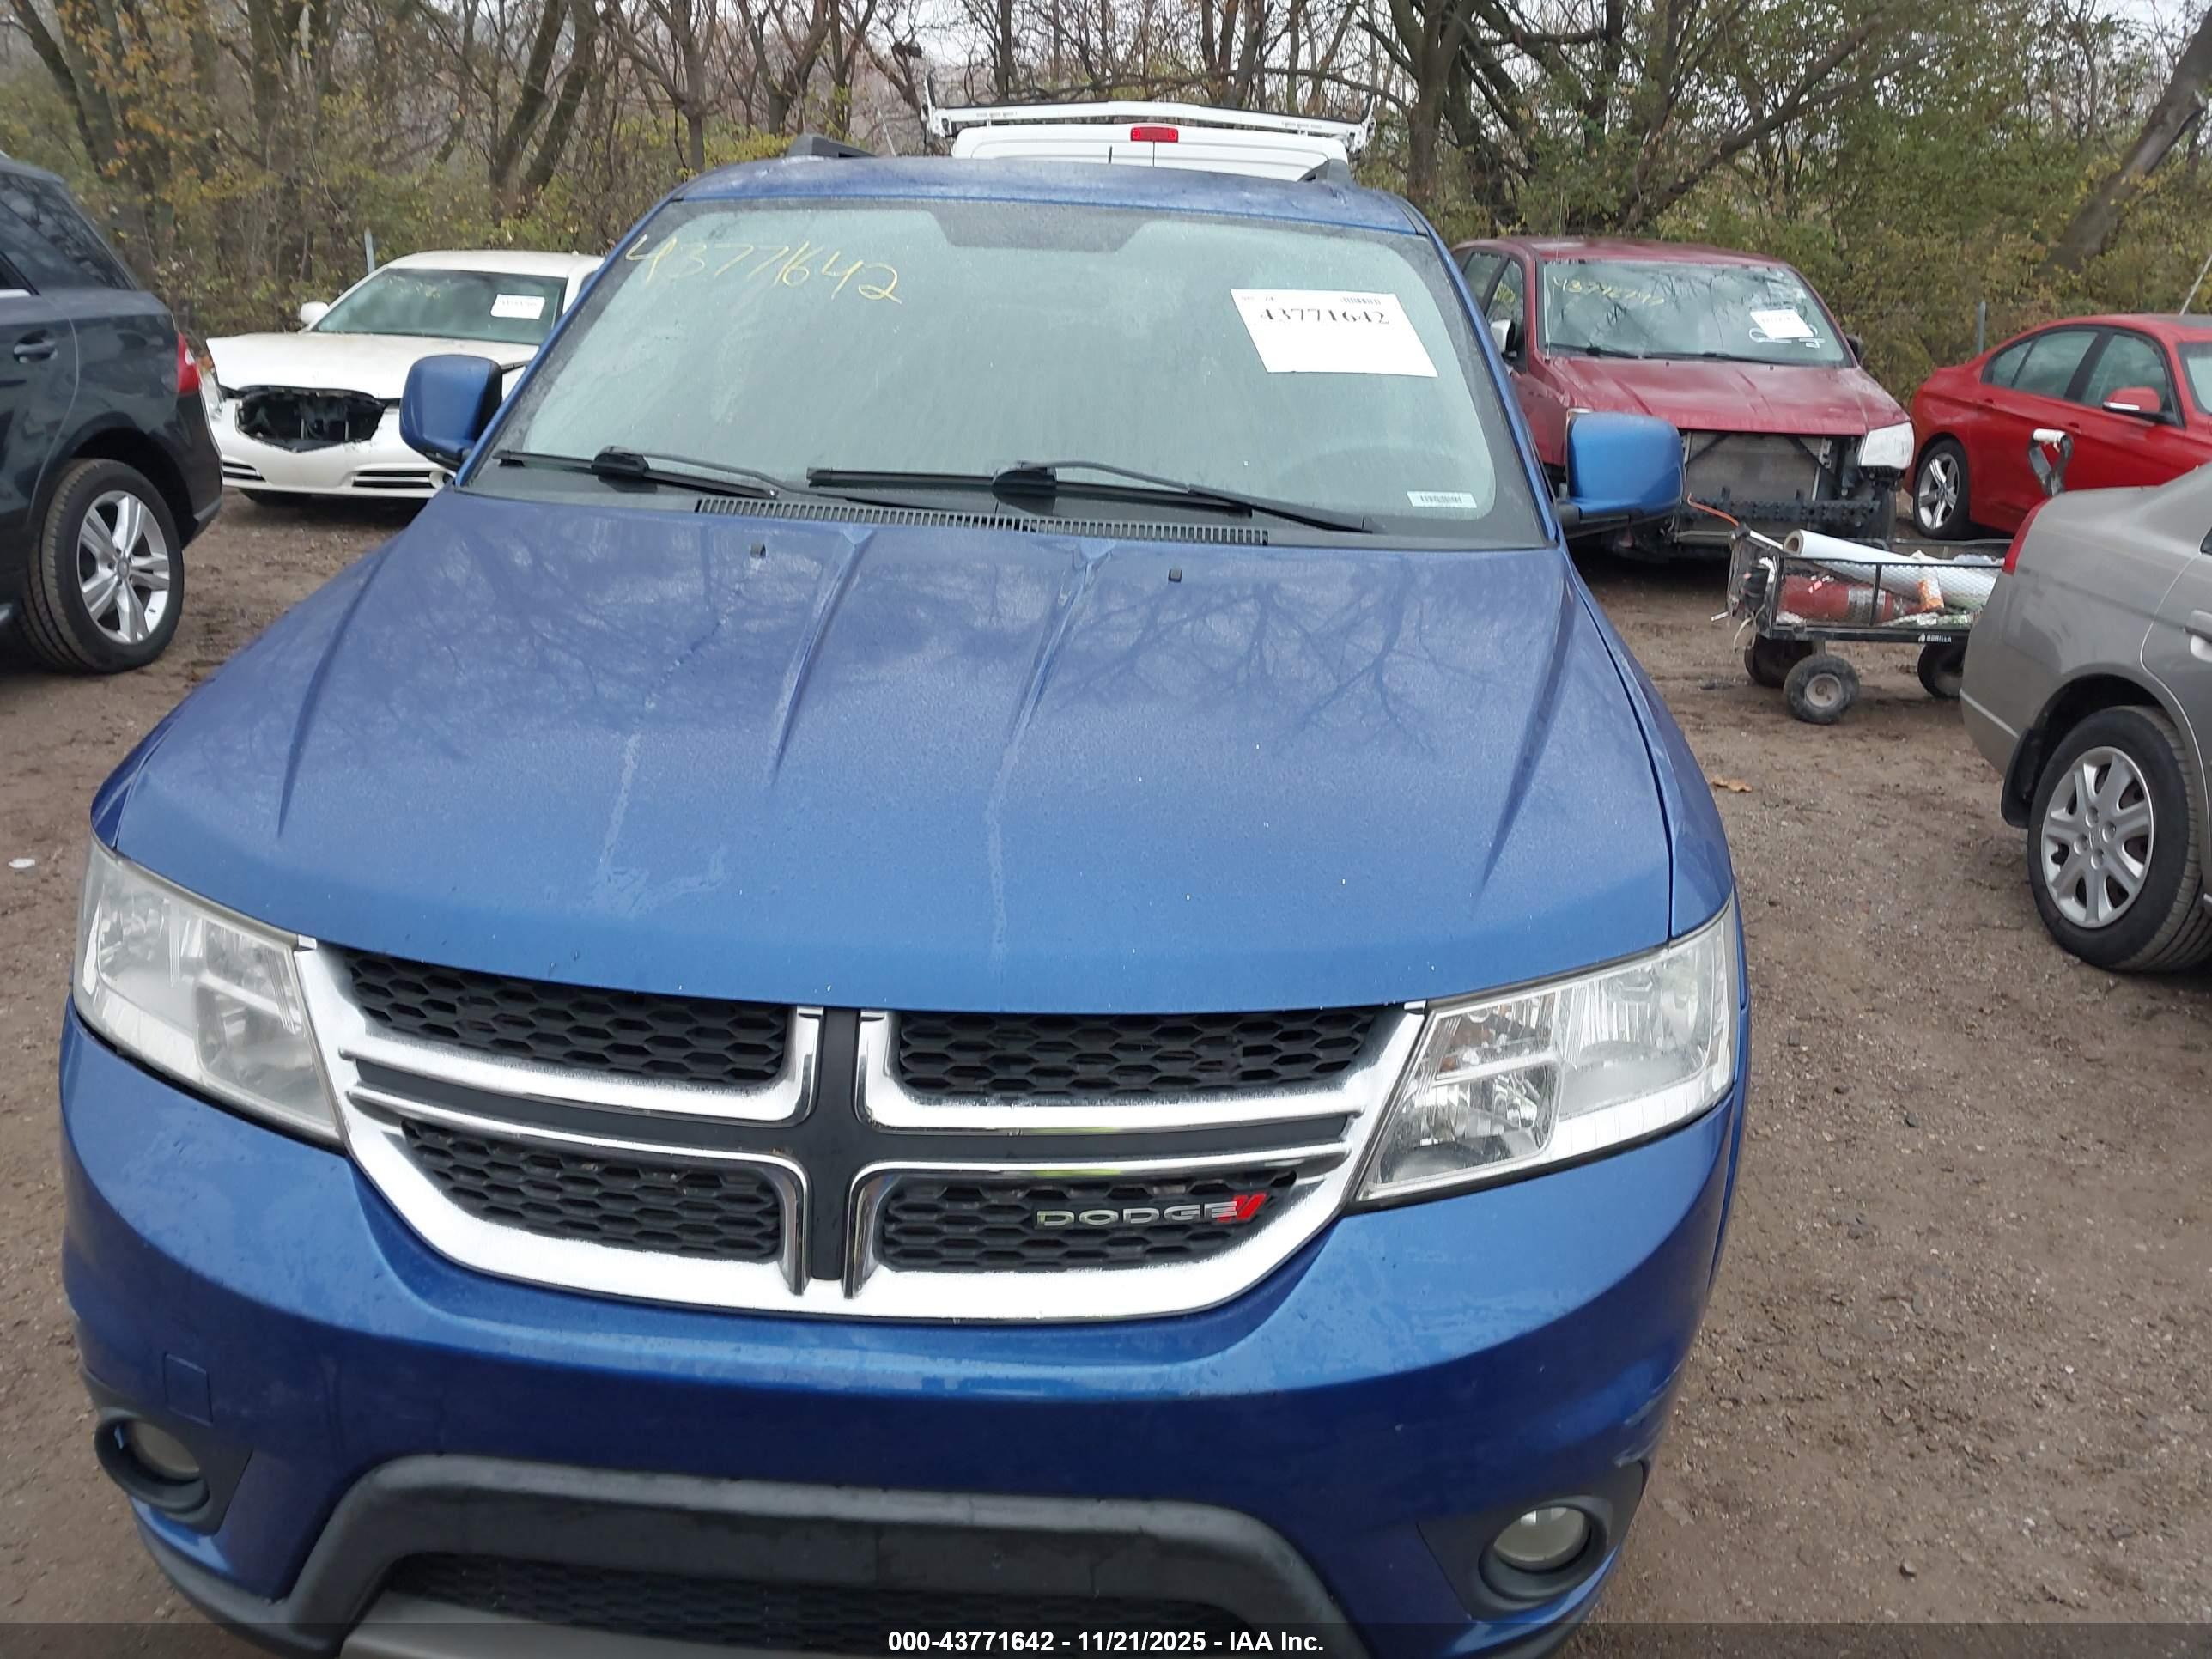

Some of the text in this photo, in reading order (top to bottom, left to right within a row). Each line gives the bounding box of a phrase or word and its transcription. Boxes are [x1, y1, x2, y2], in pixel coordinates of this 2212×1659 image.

[625, 234, 902, 304] 43771642
[1260, 308, 1389, 325] 43771642
[1036, 1200, 1237, 1226] DODGE
